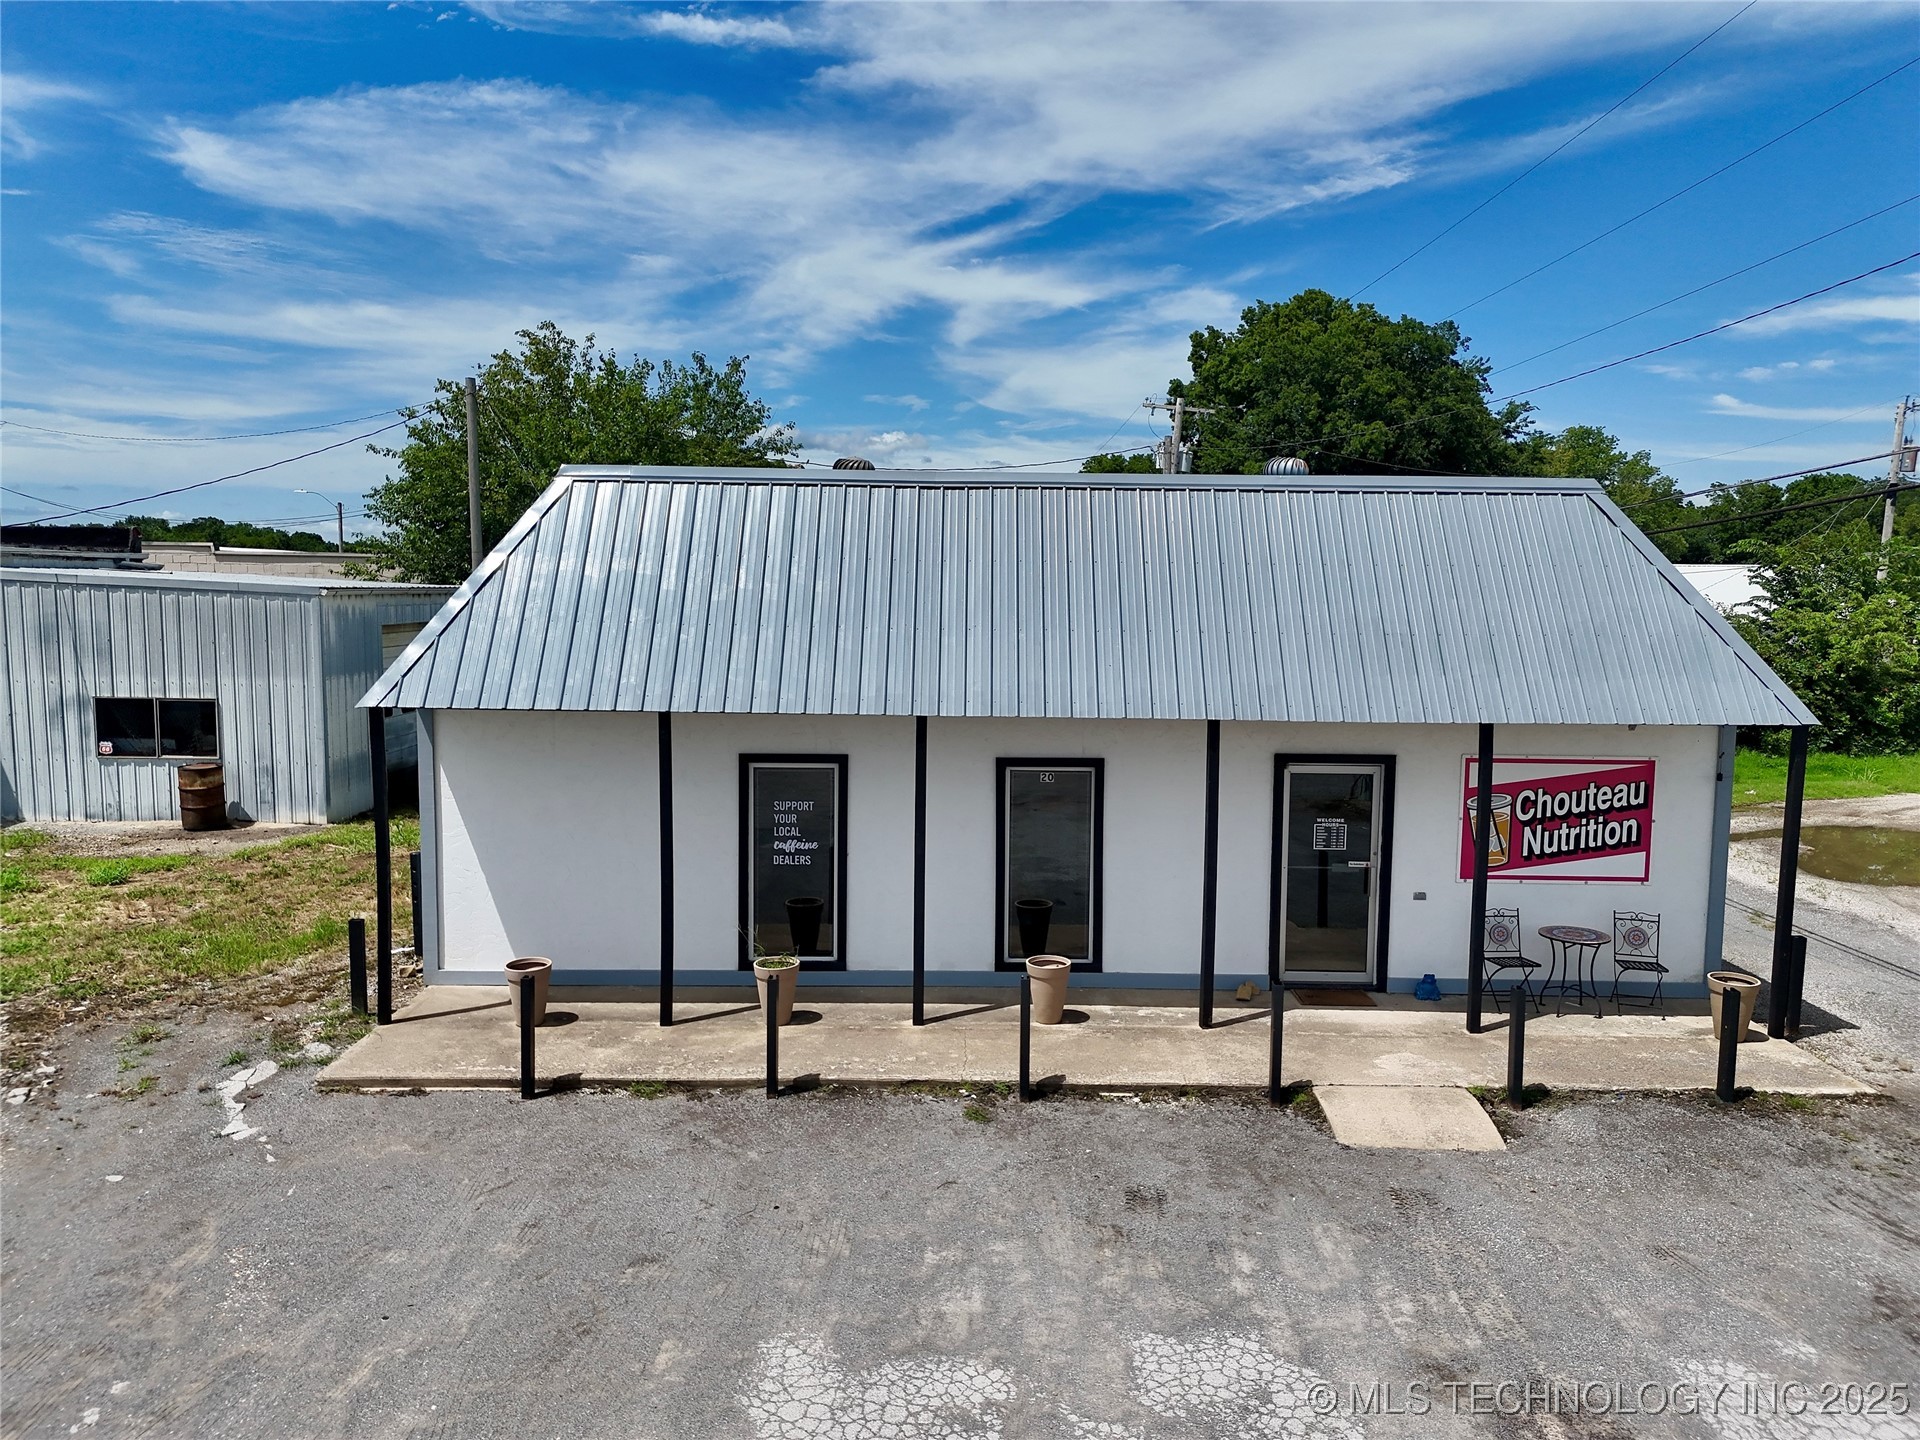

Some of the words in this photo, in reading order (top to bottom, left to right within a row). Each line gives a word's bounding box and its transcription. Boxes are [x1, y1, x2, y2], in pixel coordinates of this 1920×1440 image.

[1041, 773, 1054, 782] 20
[773, 800, 814, 811] SUPPORT
[1515, 781, 1646, 821] Chouteau
[773, 813, 797, 823] YOUR
[773, 826, 801, 837] LOCAL
[1522, 815, 1638, 857] Nutrition
[773, 838, 819, 853] caffeine
[773, 855, 811, 865] DEALERS
